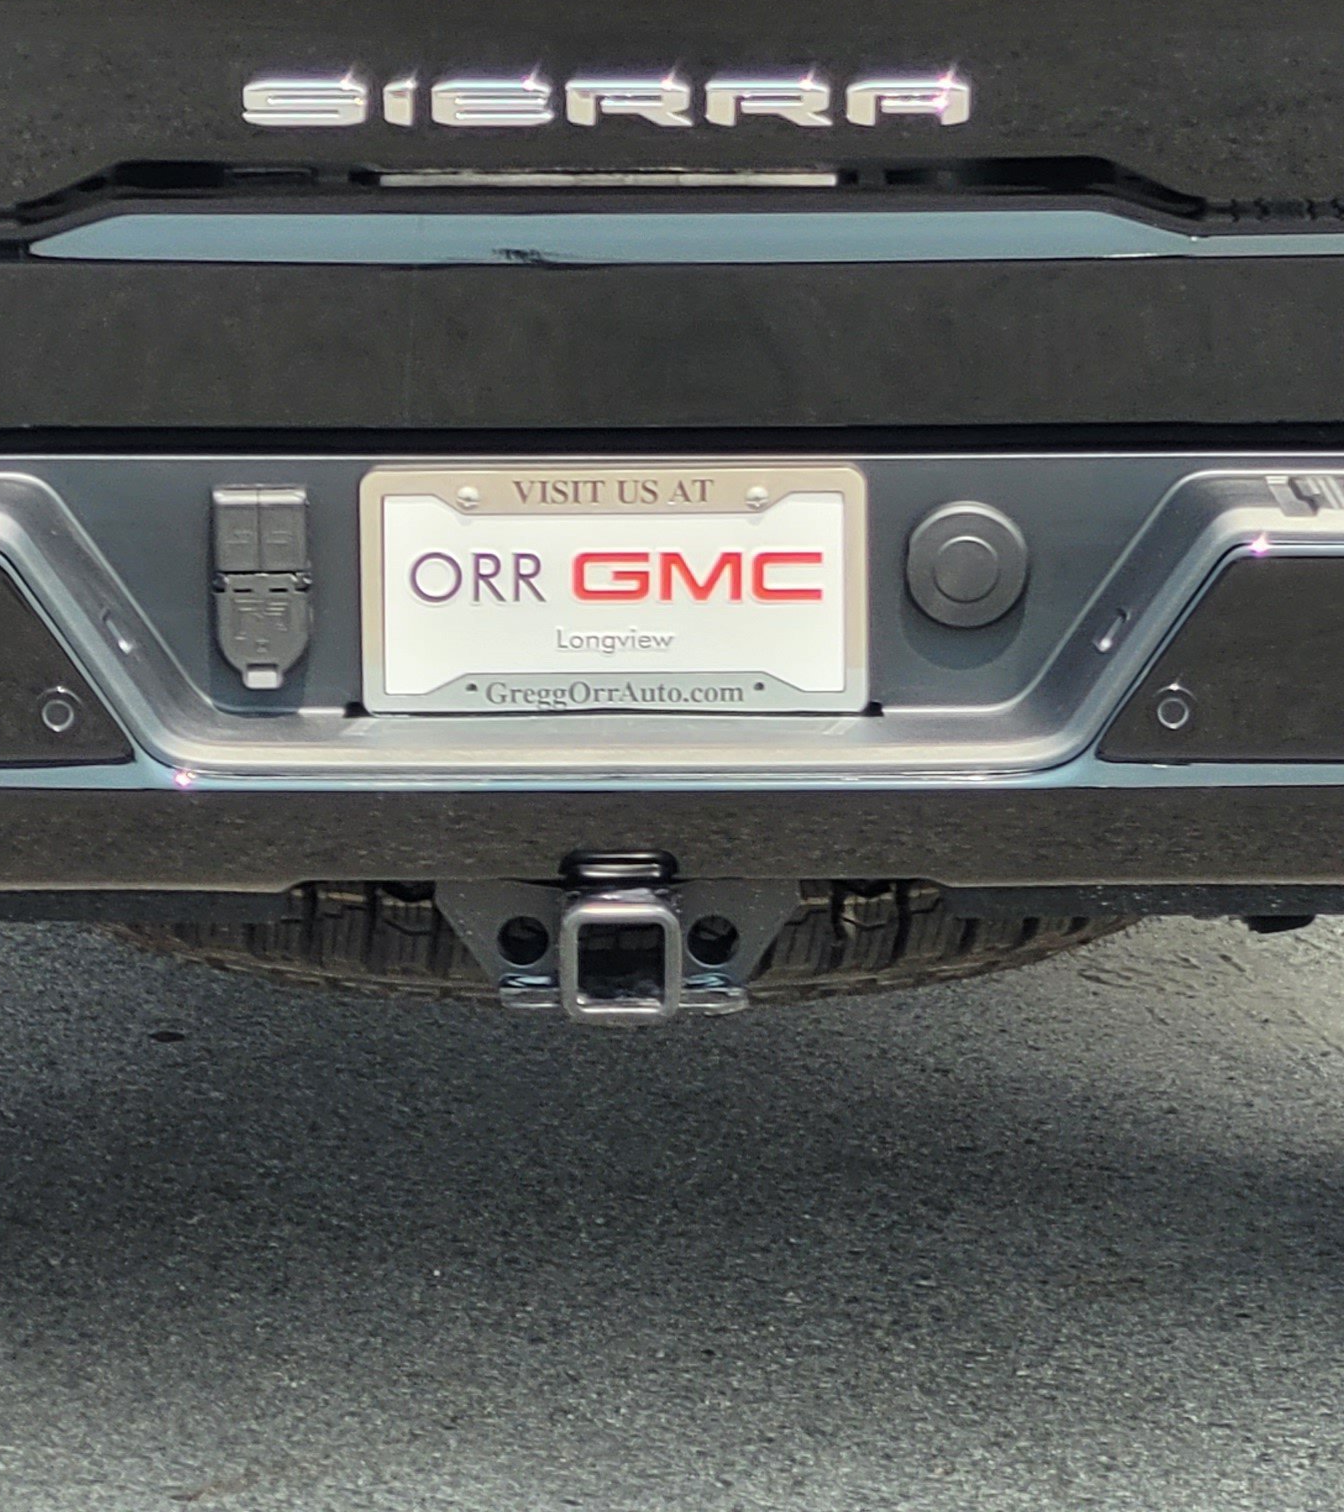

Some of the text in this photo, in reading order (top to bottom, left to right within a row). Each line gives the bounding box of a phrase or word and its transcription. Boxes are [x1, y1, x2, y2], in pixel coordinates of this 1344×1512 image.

[242, 78, 971, 127] SIERRA
[512, 479, 714, 506] VISIT US AT
[410, 551, 823, 603] ORR GMC
[555, 628, 675, 654] Longview
[485, 682, 744, 710] GreggOrrAuto.com
